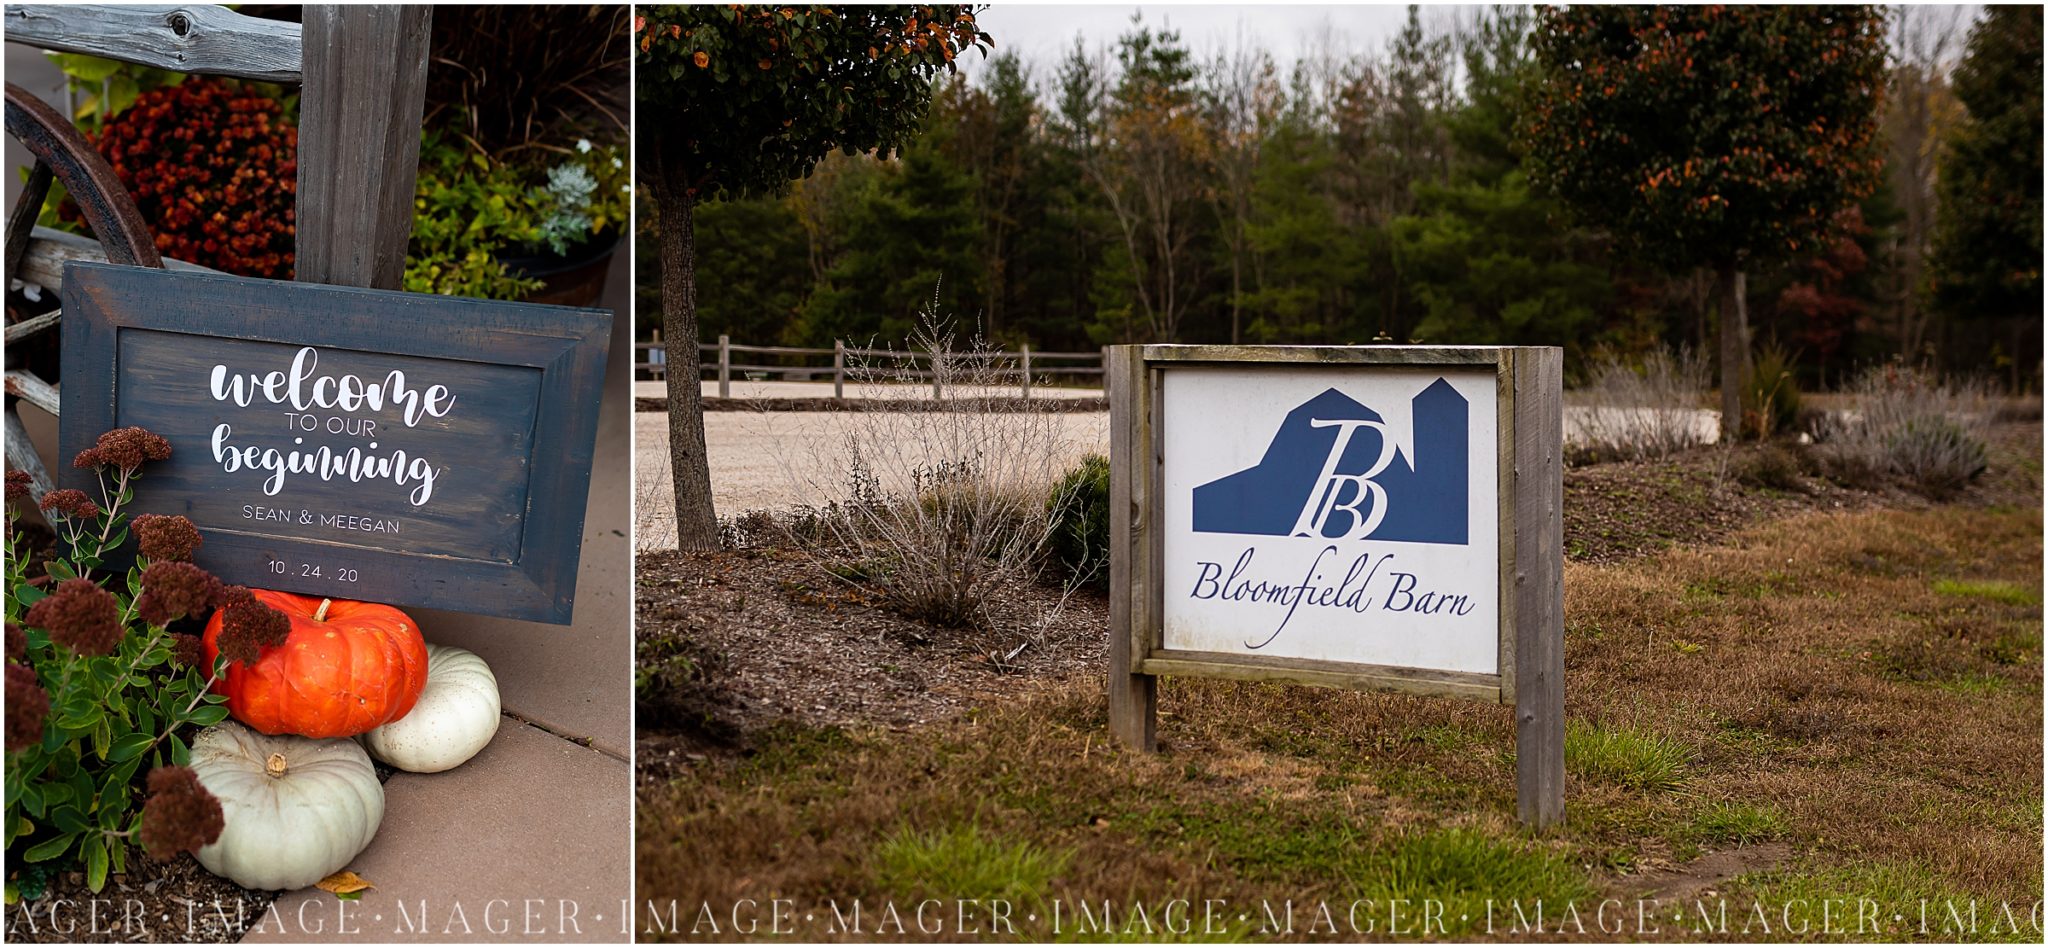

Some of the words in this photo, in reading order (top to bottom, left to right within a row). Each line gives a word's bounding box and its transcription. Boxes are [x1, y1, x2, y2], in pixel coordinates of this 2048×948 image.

[210, 346, 457, 428] welcome
[284, 412, 318, 432] TO
[326, 416, 376, 438] OUR
[211, 423, 441, 507] beginning
[242, 504, 291, 523] SEAN
[299, 509, 314, 525] &
[320, 514, 400, 534] MEEGAN
[1190, 545, 1394, 650] Bloomfield
[1383, 572, 1476, 617] Barn
